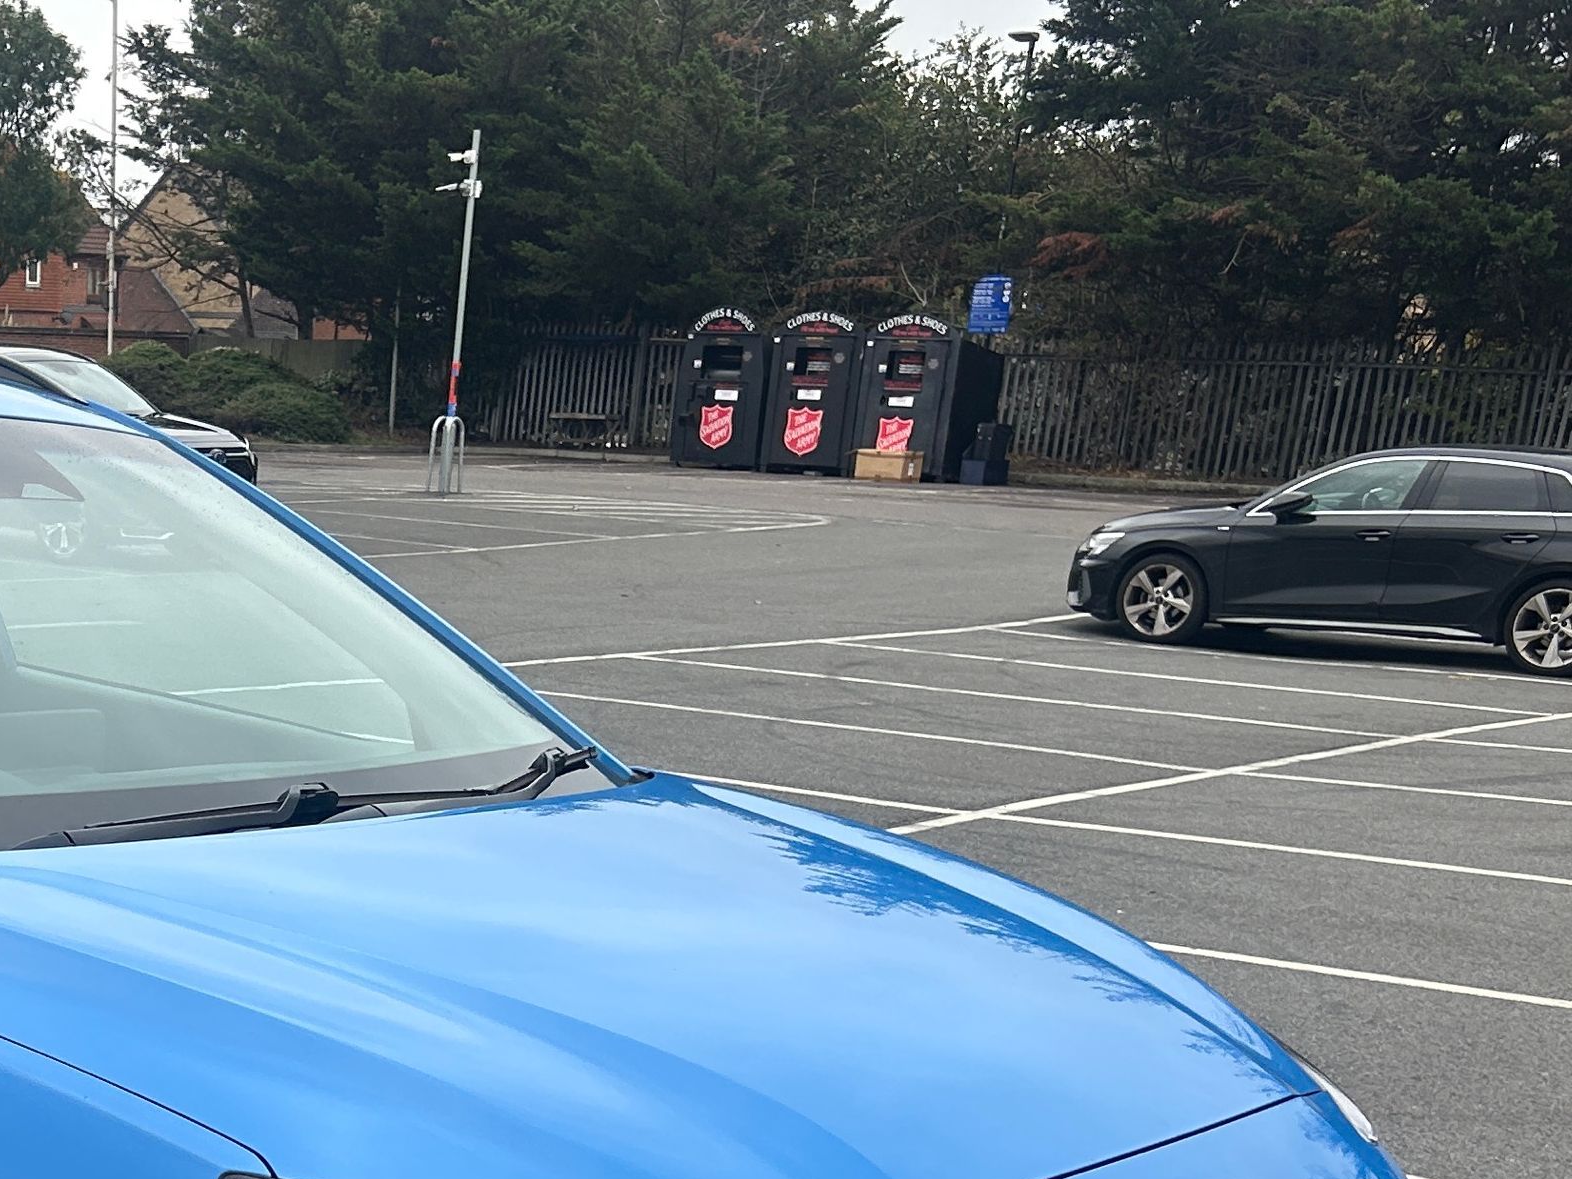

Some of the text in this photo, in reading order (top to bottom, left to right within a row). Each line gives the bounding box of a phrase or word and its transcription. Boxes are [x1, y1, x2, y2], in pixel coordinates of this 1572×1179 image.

[694, 307, 726, 332] CLOTHES
[726, 308, 732, 317] &
[732, 310, 756, 332] SHOES
[787, 312, 822, 329] CLOTHES
[822, 312, 828, 321] &
[829, 313, 855, 332] SHOES
[878, 314, 915, 333] CLOTHES
[915, 315, 921, 325] &
[921, 316, 948, 335] SHOES
